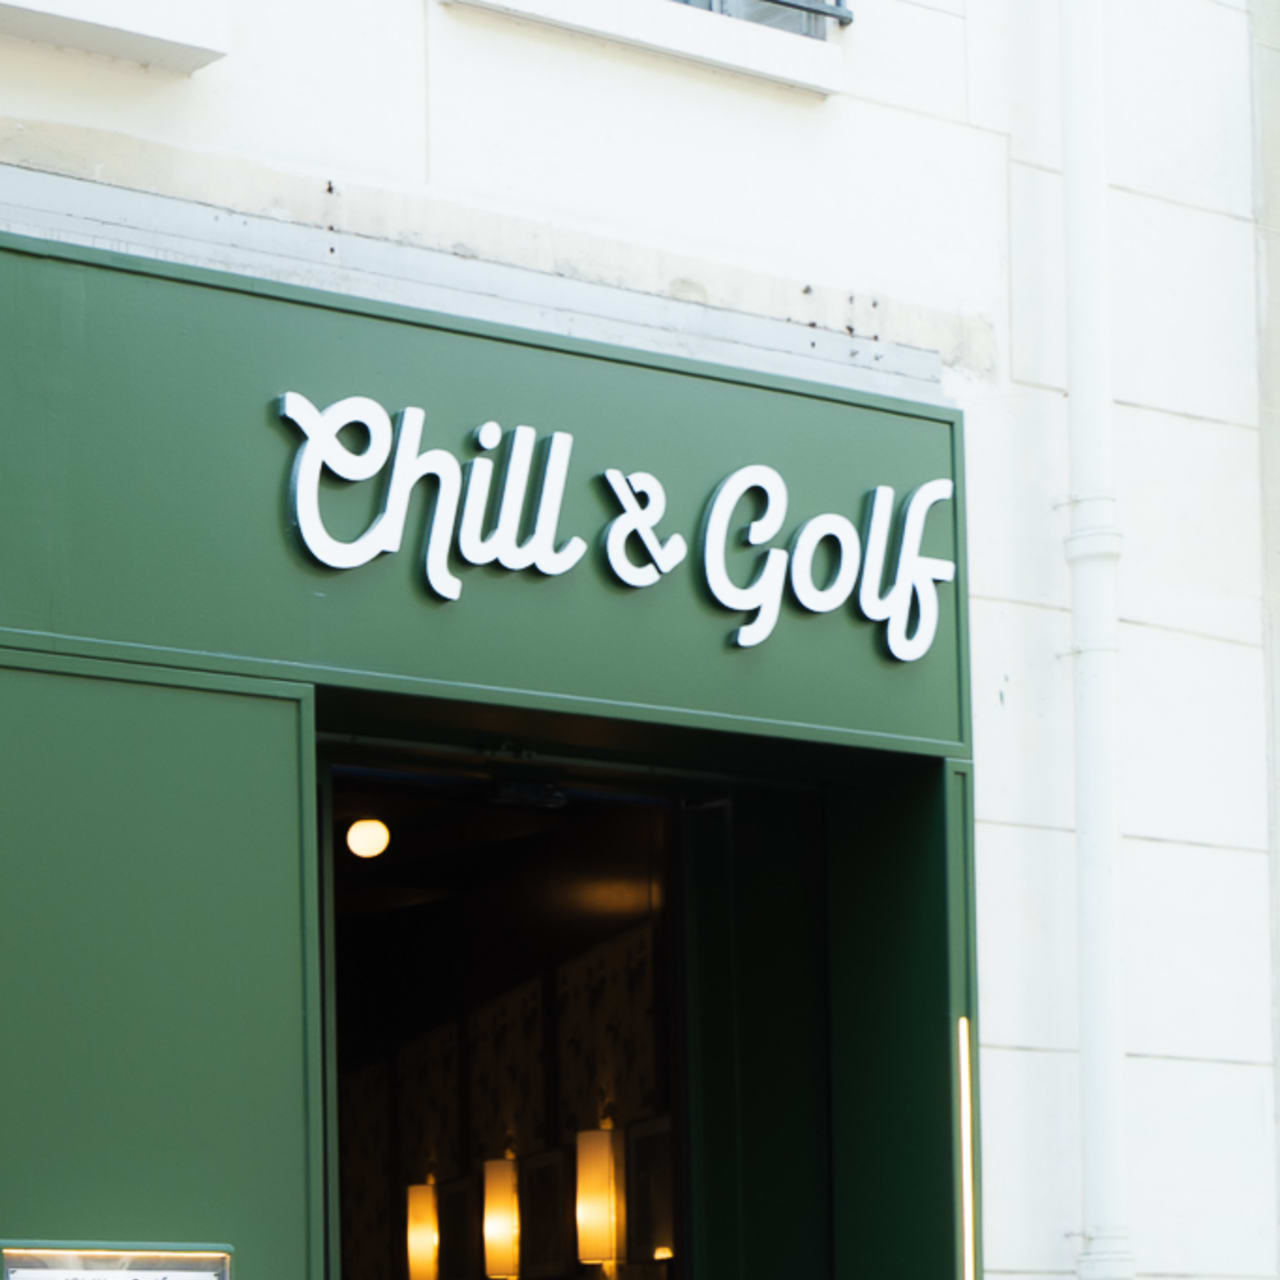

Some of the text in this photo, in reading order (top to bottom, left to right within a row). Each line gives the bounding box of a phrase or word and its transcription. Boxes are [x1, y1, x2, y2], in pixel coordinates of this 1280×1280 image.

[278, 390, 956, 662] Chill & Golf
